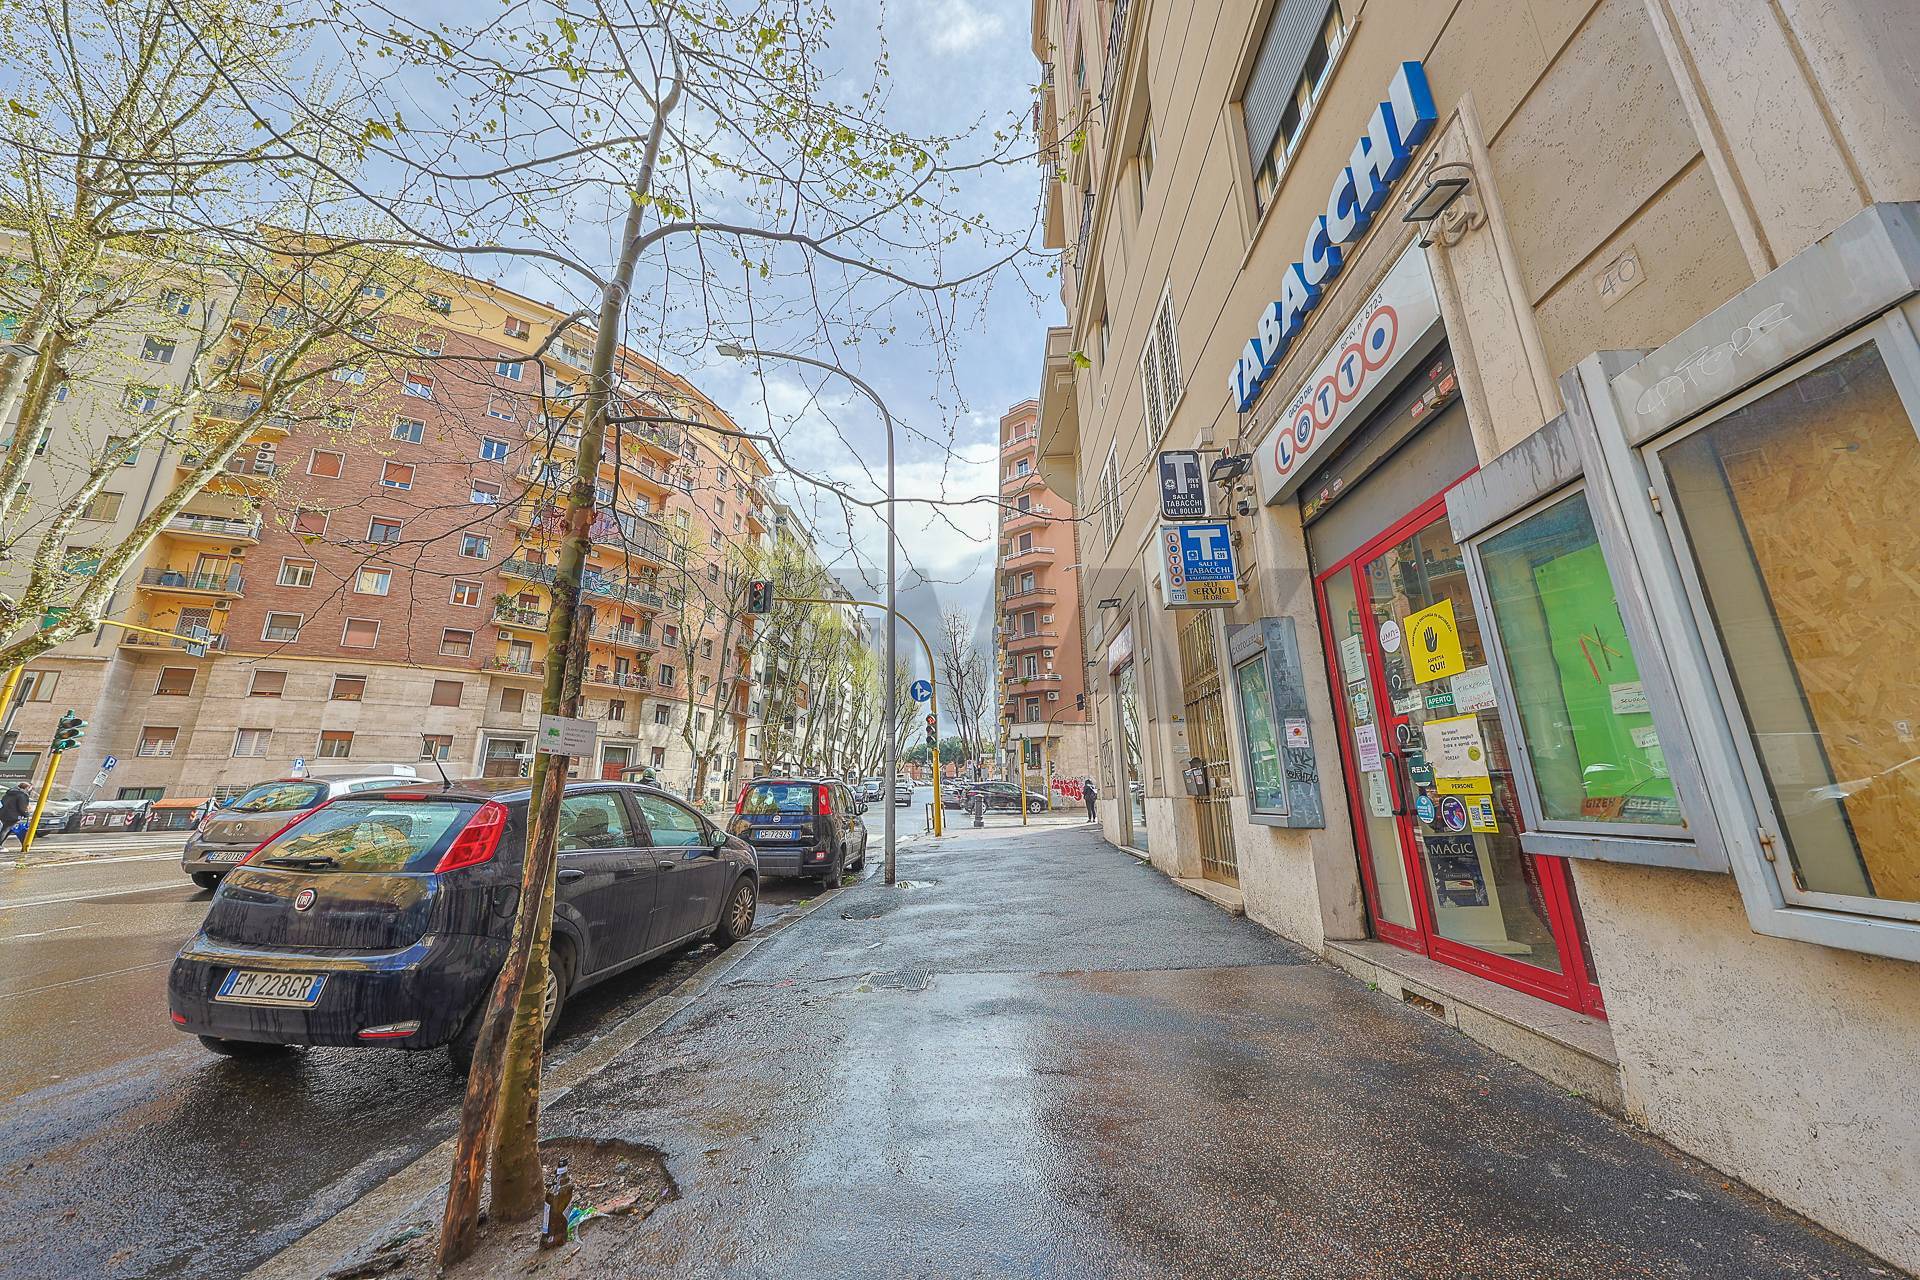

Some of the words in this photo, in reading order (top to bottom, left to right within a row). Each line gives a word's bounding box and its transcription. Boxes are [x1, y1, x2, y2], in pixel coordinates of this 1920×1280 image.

[1228, 61, 1439, 414] TABACCHI
[1601, 257, 1637, 297] 40
[1365, 293, 1384, 319] 6723
[1275, 305, 1399, 475] LOTTO
[1288, 399, 1304, 419] GIOCO
[1303, 385, 1314, 400] DEL
[1164, 455, 1195, 493] T
[1166, 499, 1203, 507] TABACCHI
[1180, 507, 1203, 515] BOLLATI
[1188, 529, 1221, 560] T
[1166, 532, 1185, 588] LOTTO
[1188, 566, 1231, 574] TABACCHI
[1193, 587, 1231, 595] SERVICE
[1427, 655, 1445, 663] ASPETTA
[1429, 661, 1446, 673] QUI!
[1428, 695, 1452, 705] APERTO
[1412, 766, 1430, 774] RELX
[1586, 797, 1616, 808] GIZEH
[1430, 843, 1474, 854] MAGIC
